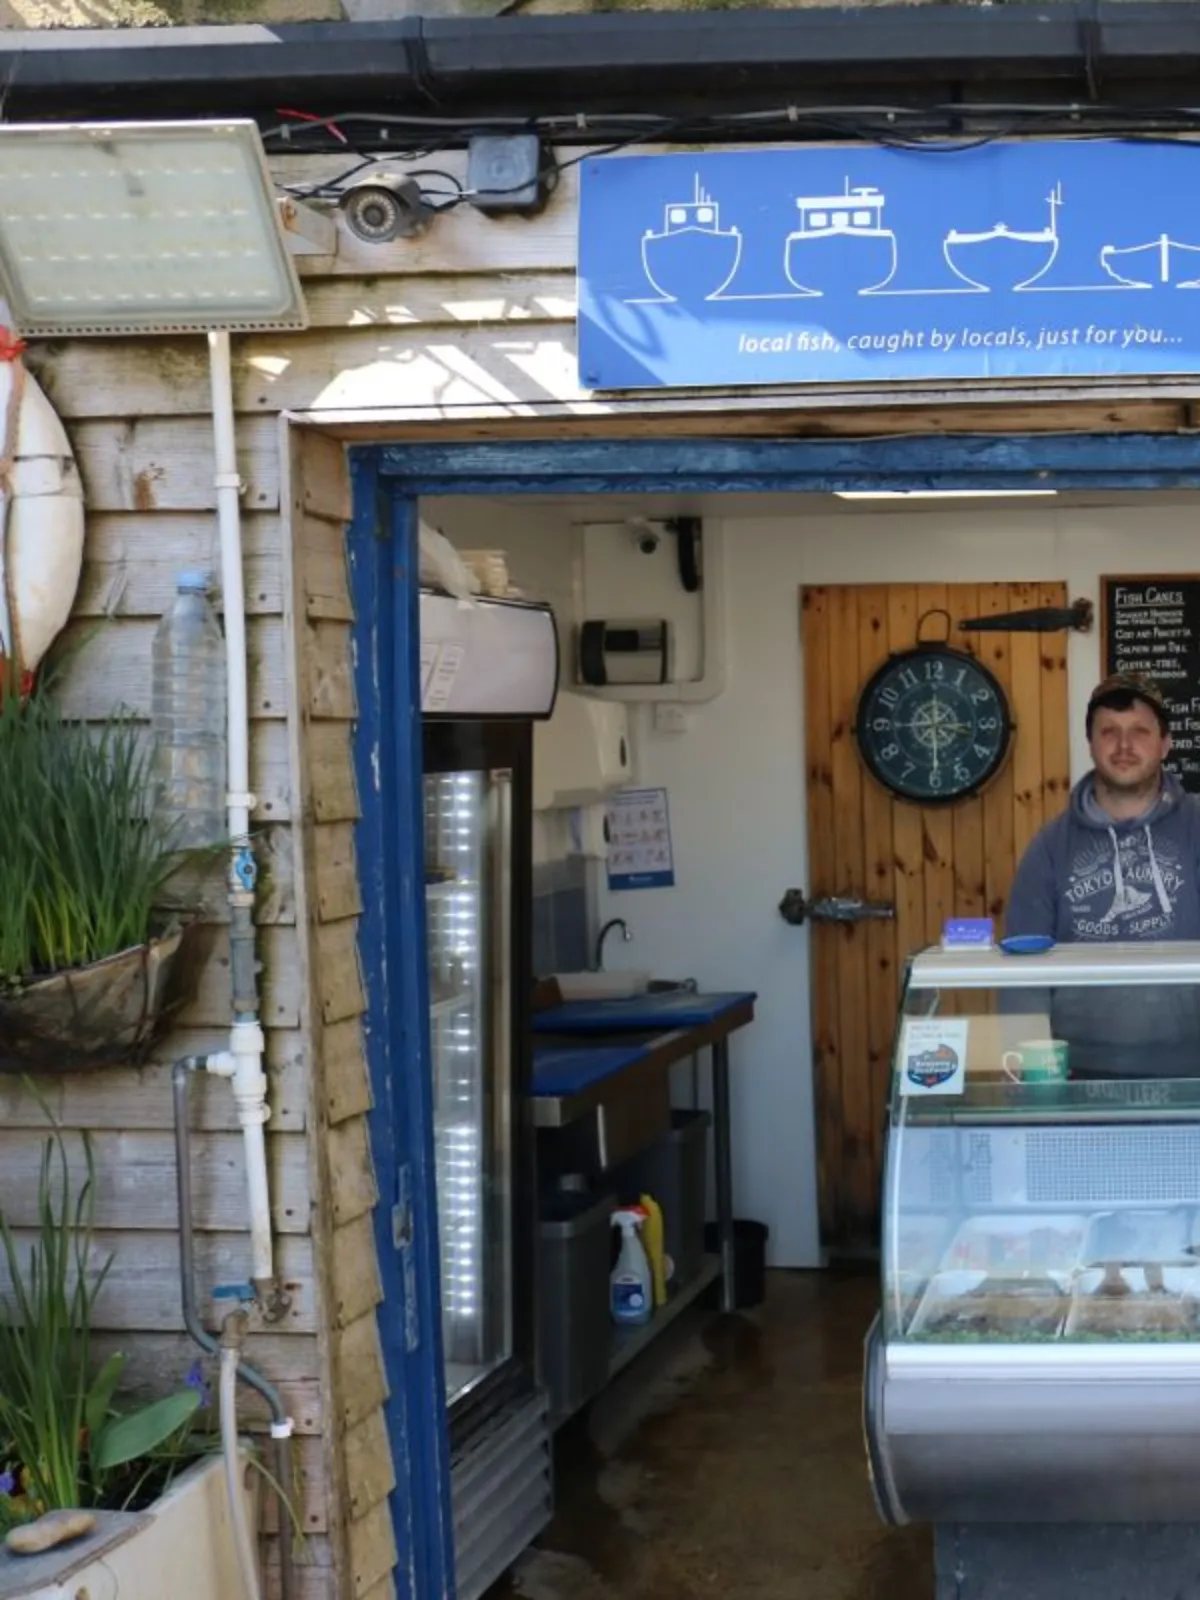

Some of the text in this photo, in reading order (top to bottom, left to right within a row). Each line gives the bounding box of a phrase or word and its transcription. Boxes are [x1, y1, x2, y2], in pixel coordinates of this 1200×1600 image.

[738, 324, 1184, 353] local fish, caught by locals, just for you...
[898, 667, 919, 689] 11
[924, 660, 944, 680] 12
[1064, 867, 1114, 903] TOKYO
